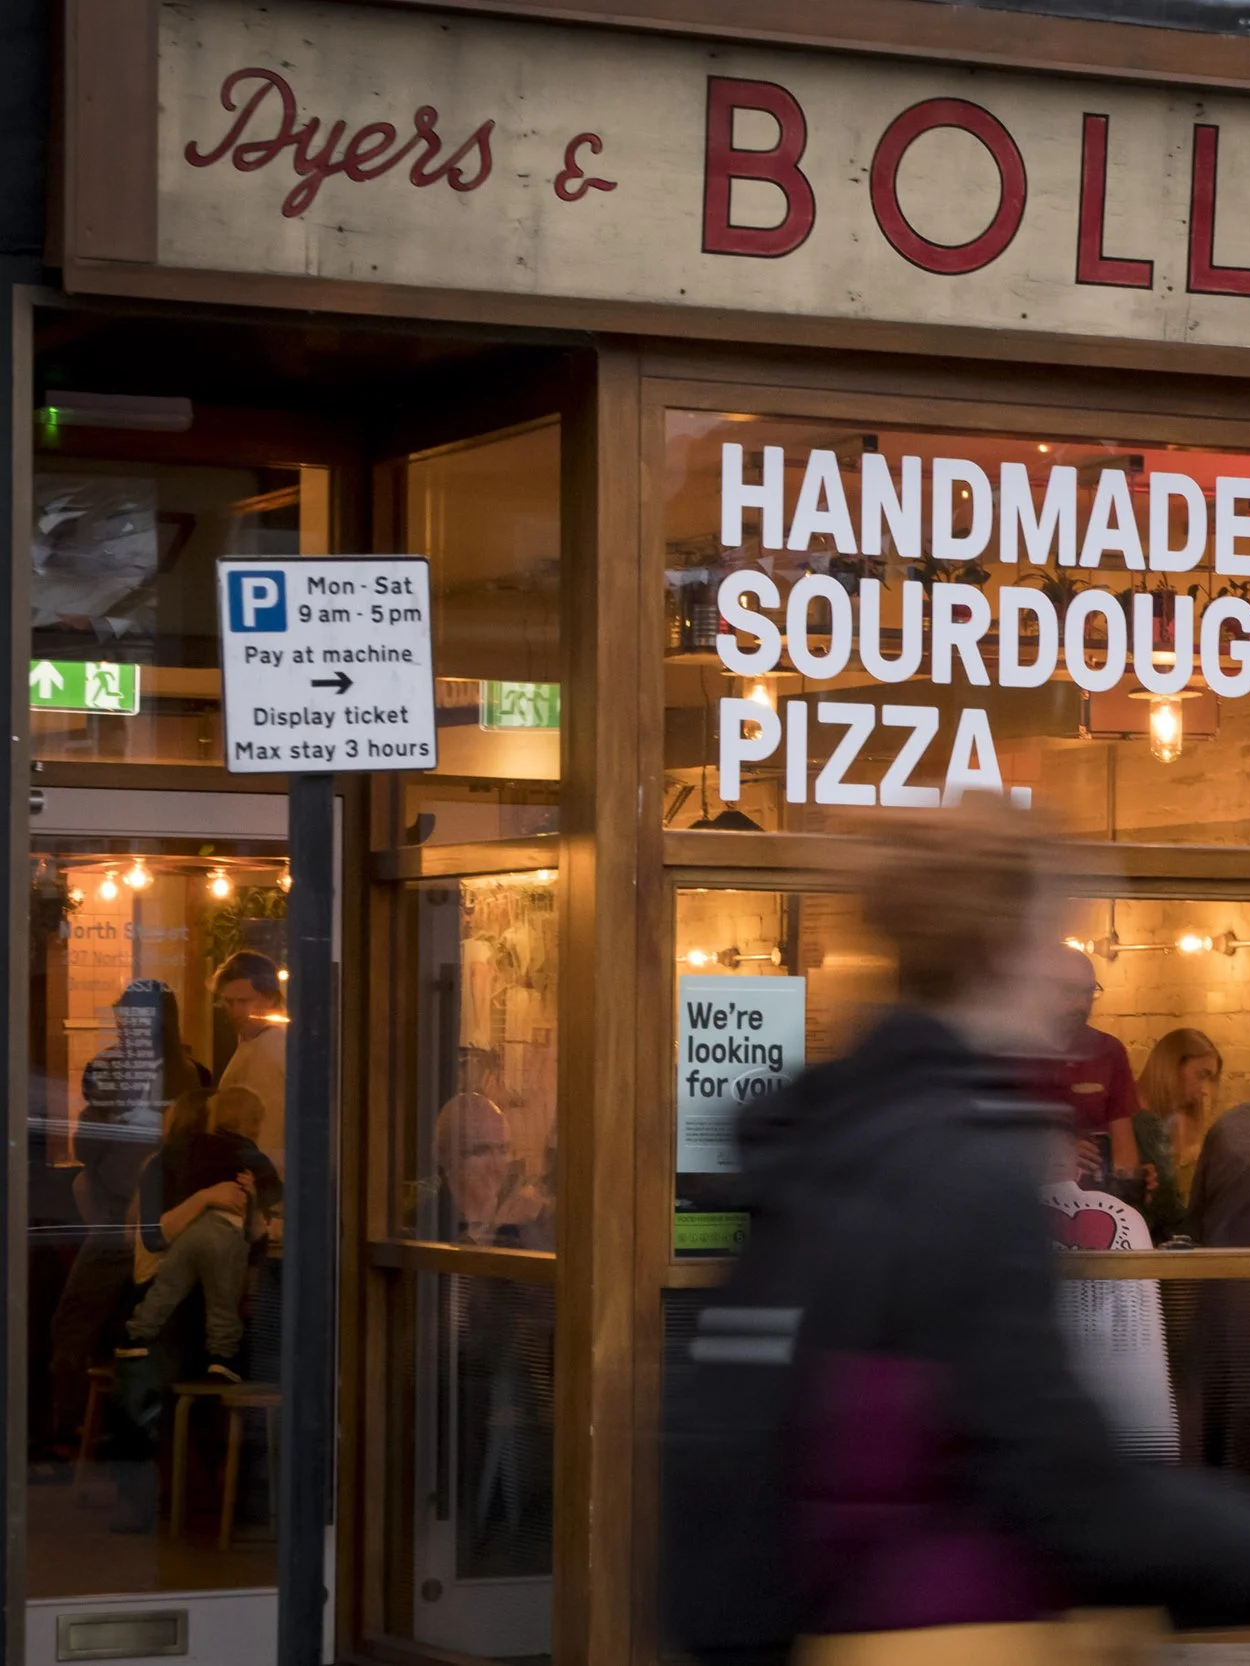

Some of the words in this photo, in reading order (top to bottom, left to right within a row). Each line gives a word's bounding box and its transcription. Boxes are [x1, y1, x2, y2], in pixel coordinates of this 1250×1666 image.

[185, 66, 497, 218] Dyers
[553, 132, 618, 202] &
[307, 576, 355, 595] Mon
[374, 576, 413, 595] Sat
[241, 577, 279, 628] P
[244, 646, 284, 668] Pay
[293, 646, 314, 664] at
[323, 645, 413, 663] machine
[253, 706, 336, 729] Display
[344, 706, 409, 725] ticket
[235, 741, 282, 760] Max
[290, 741, 336, 762] stay
[346, 739, 359, 758] 3
[368, 739, 430, 757] hours
[686, 1001, 764, 1030] We're
[687, 1035, 783, 1073] looking
[686, 1069, 729, 1098] for
